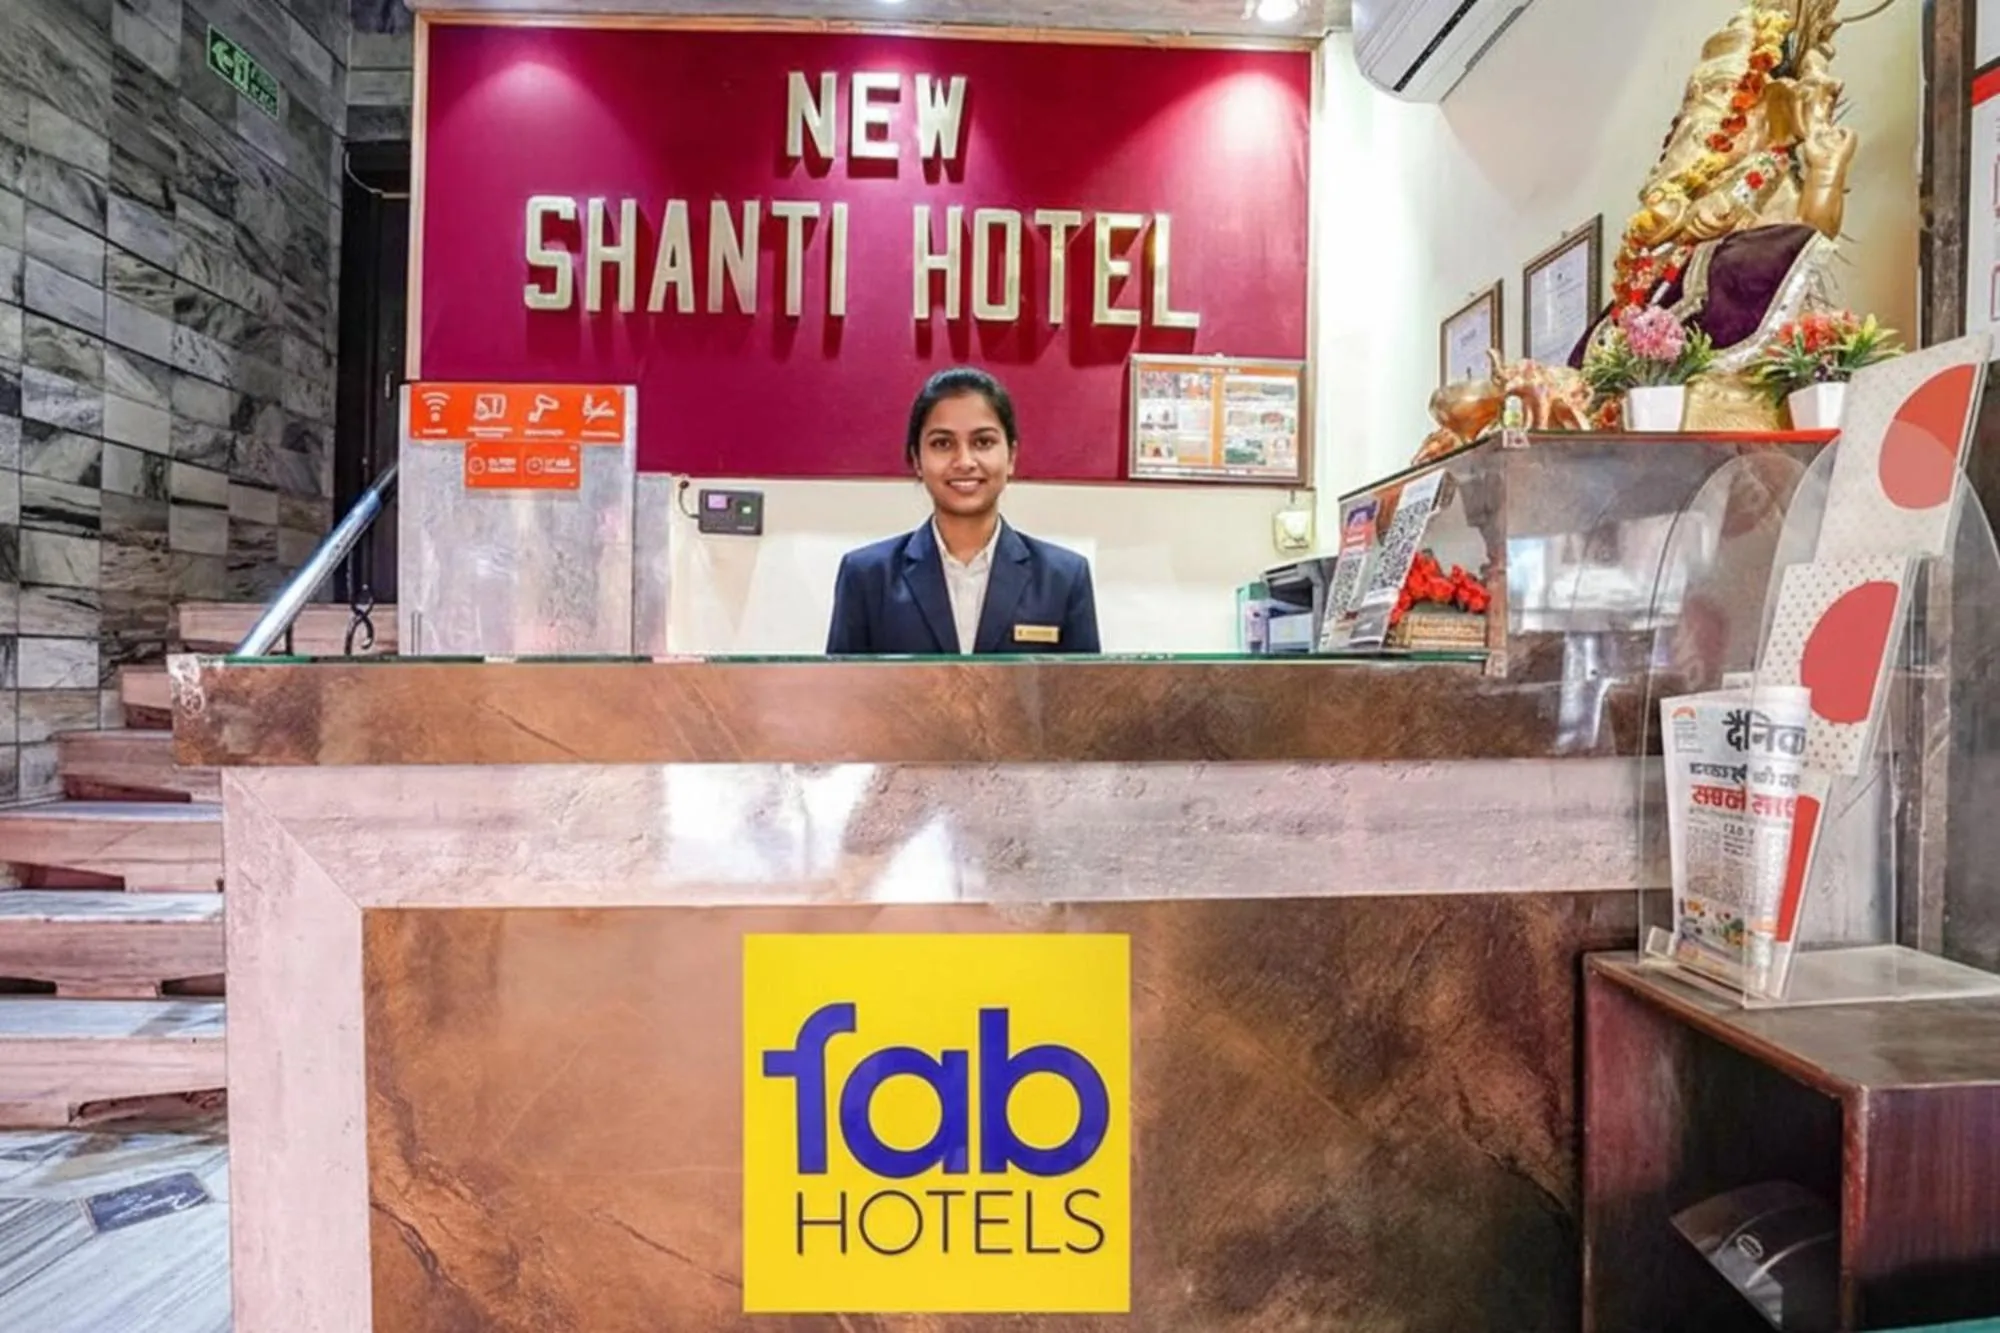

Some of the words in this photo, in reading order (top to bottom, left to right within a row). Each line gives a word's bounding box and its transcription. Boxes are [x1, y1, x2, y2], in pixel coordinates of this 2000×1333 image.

[787, 71, 967, 160] NEW
[523, 195, 849, 317] SHANTI
[912, 205, 1200, 328] HOTEL
[762, 1002, 1111, 1178] fab
[796, 1188, 1105, 1256] HOTELS
